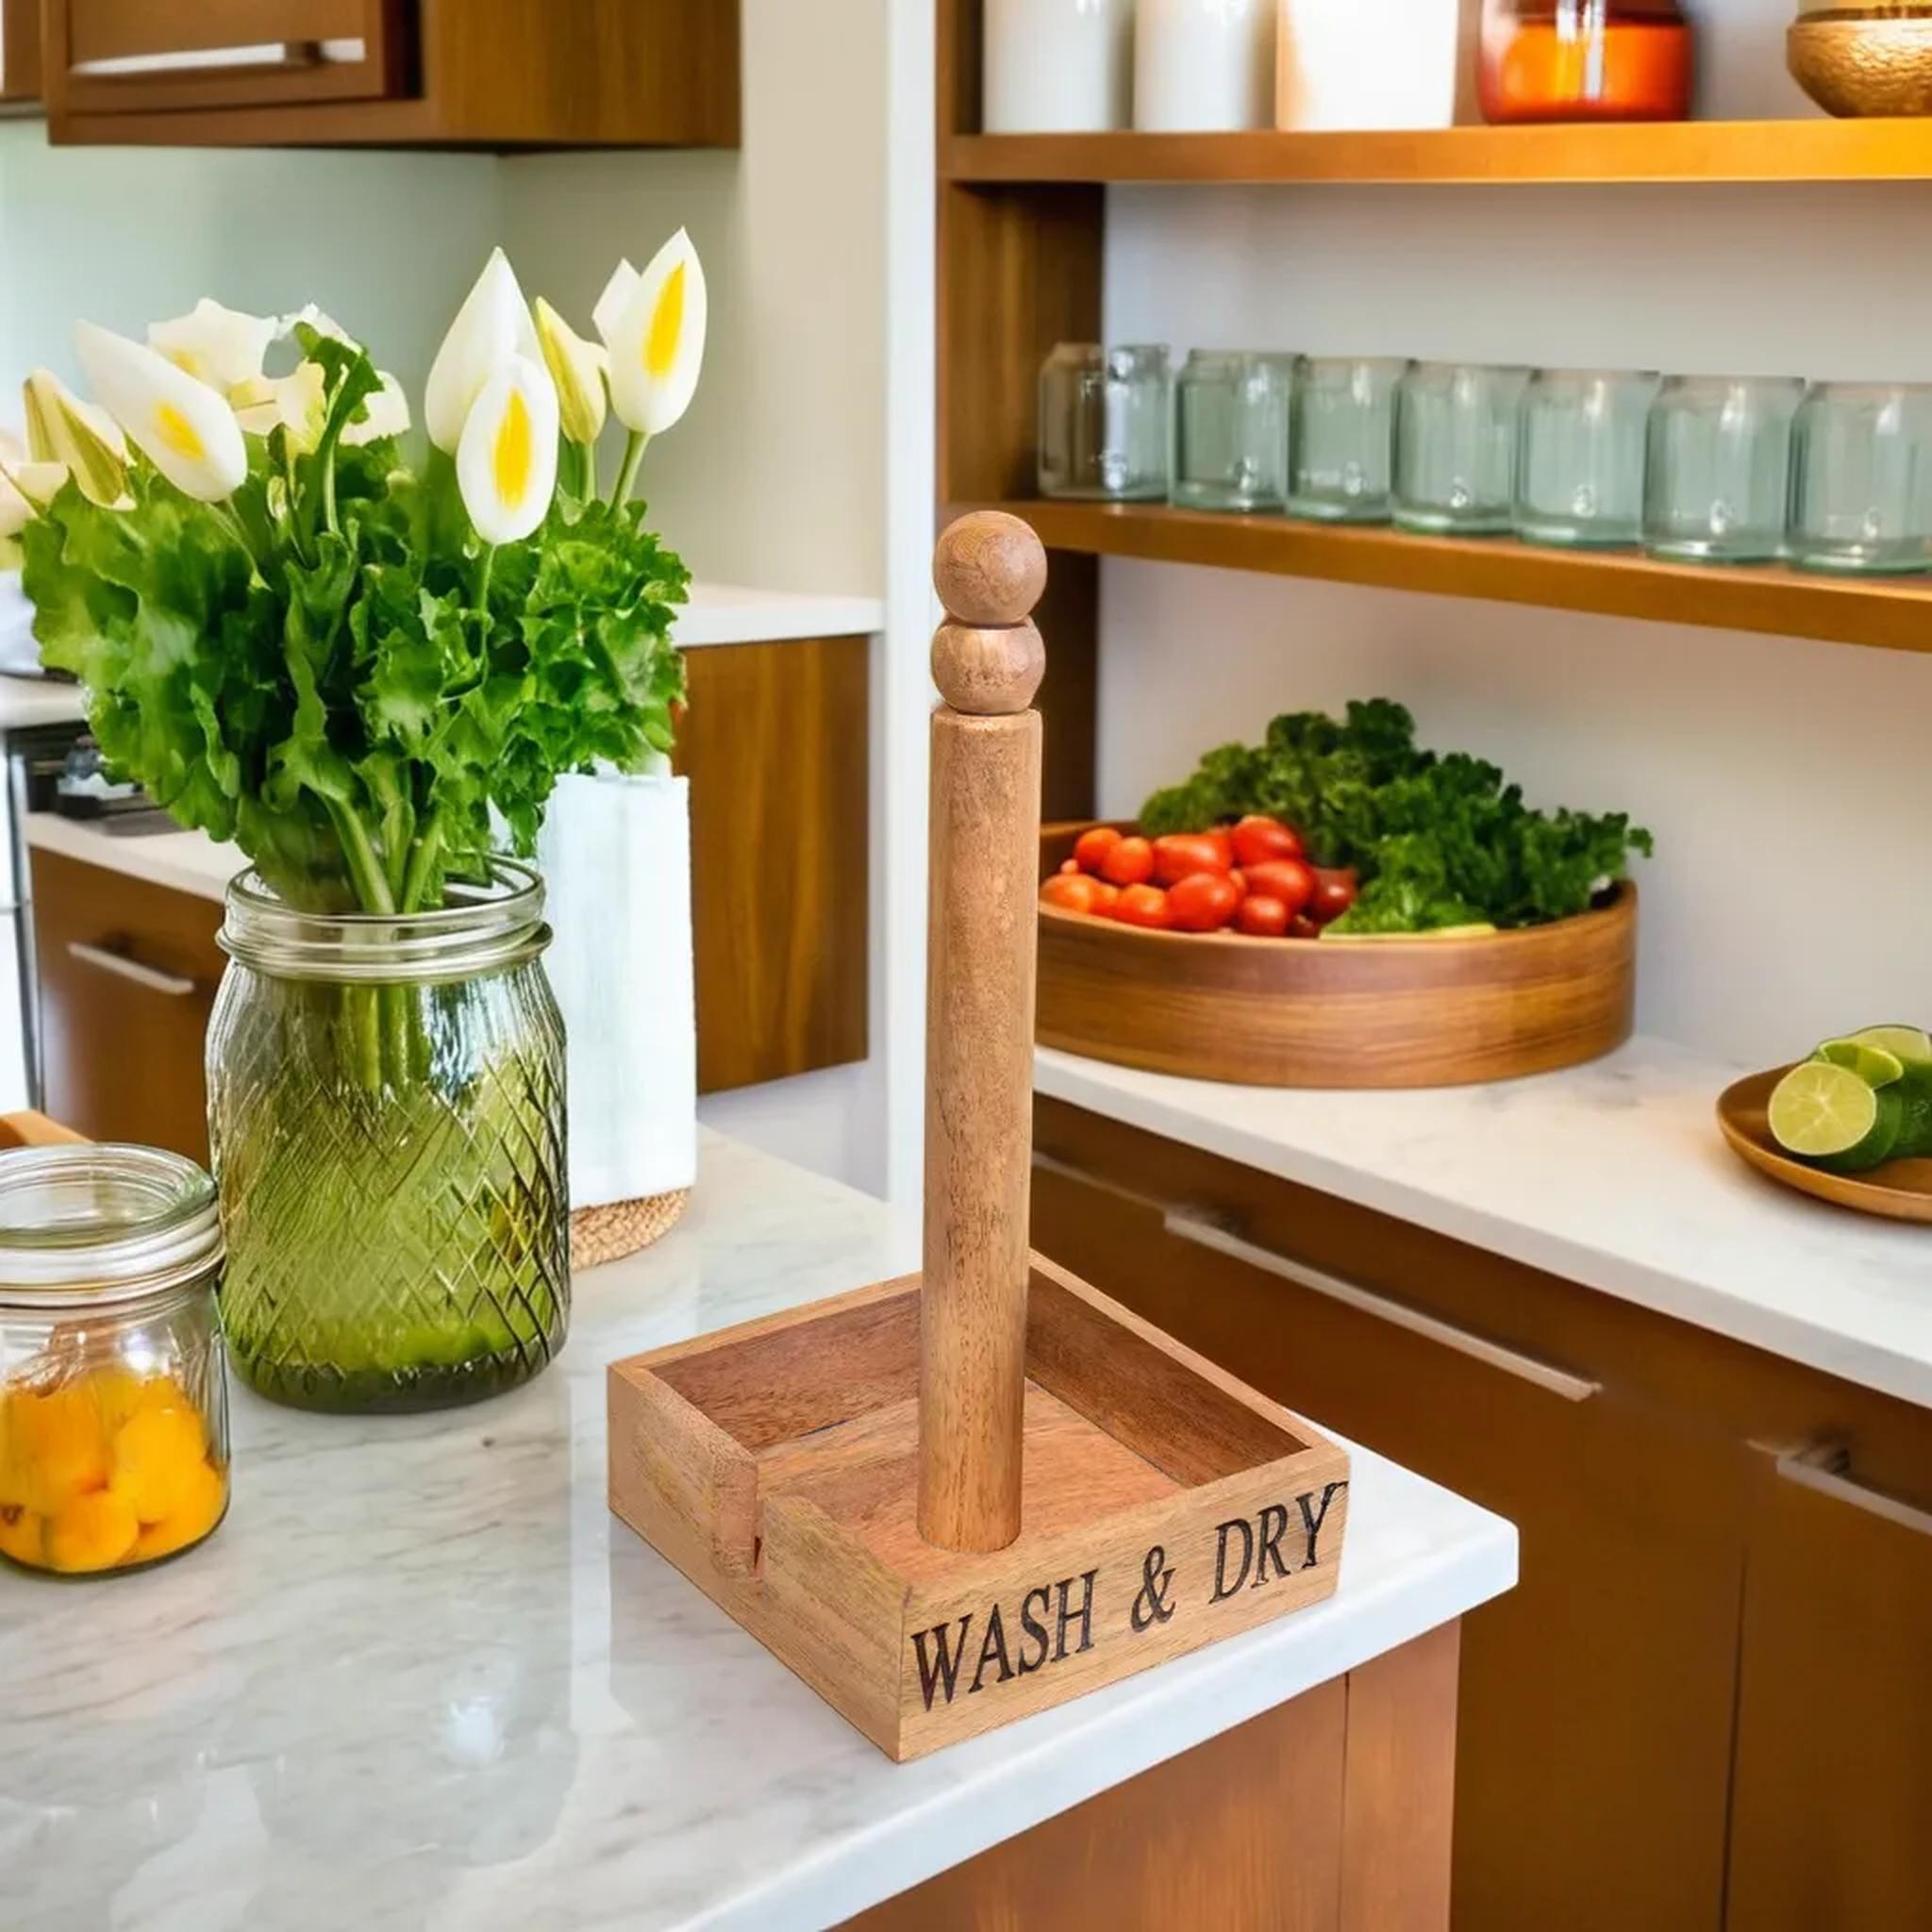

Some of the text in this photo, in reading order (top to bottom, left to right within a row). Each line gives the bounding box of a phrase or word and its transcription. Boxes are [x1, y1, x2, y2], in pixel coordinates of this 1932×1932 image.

[910, 1480, 1349, 1712] WASH & DRY
